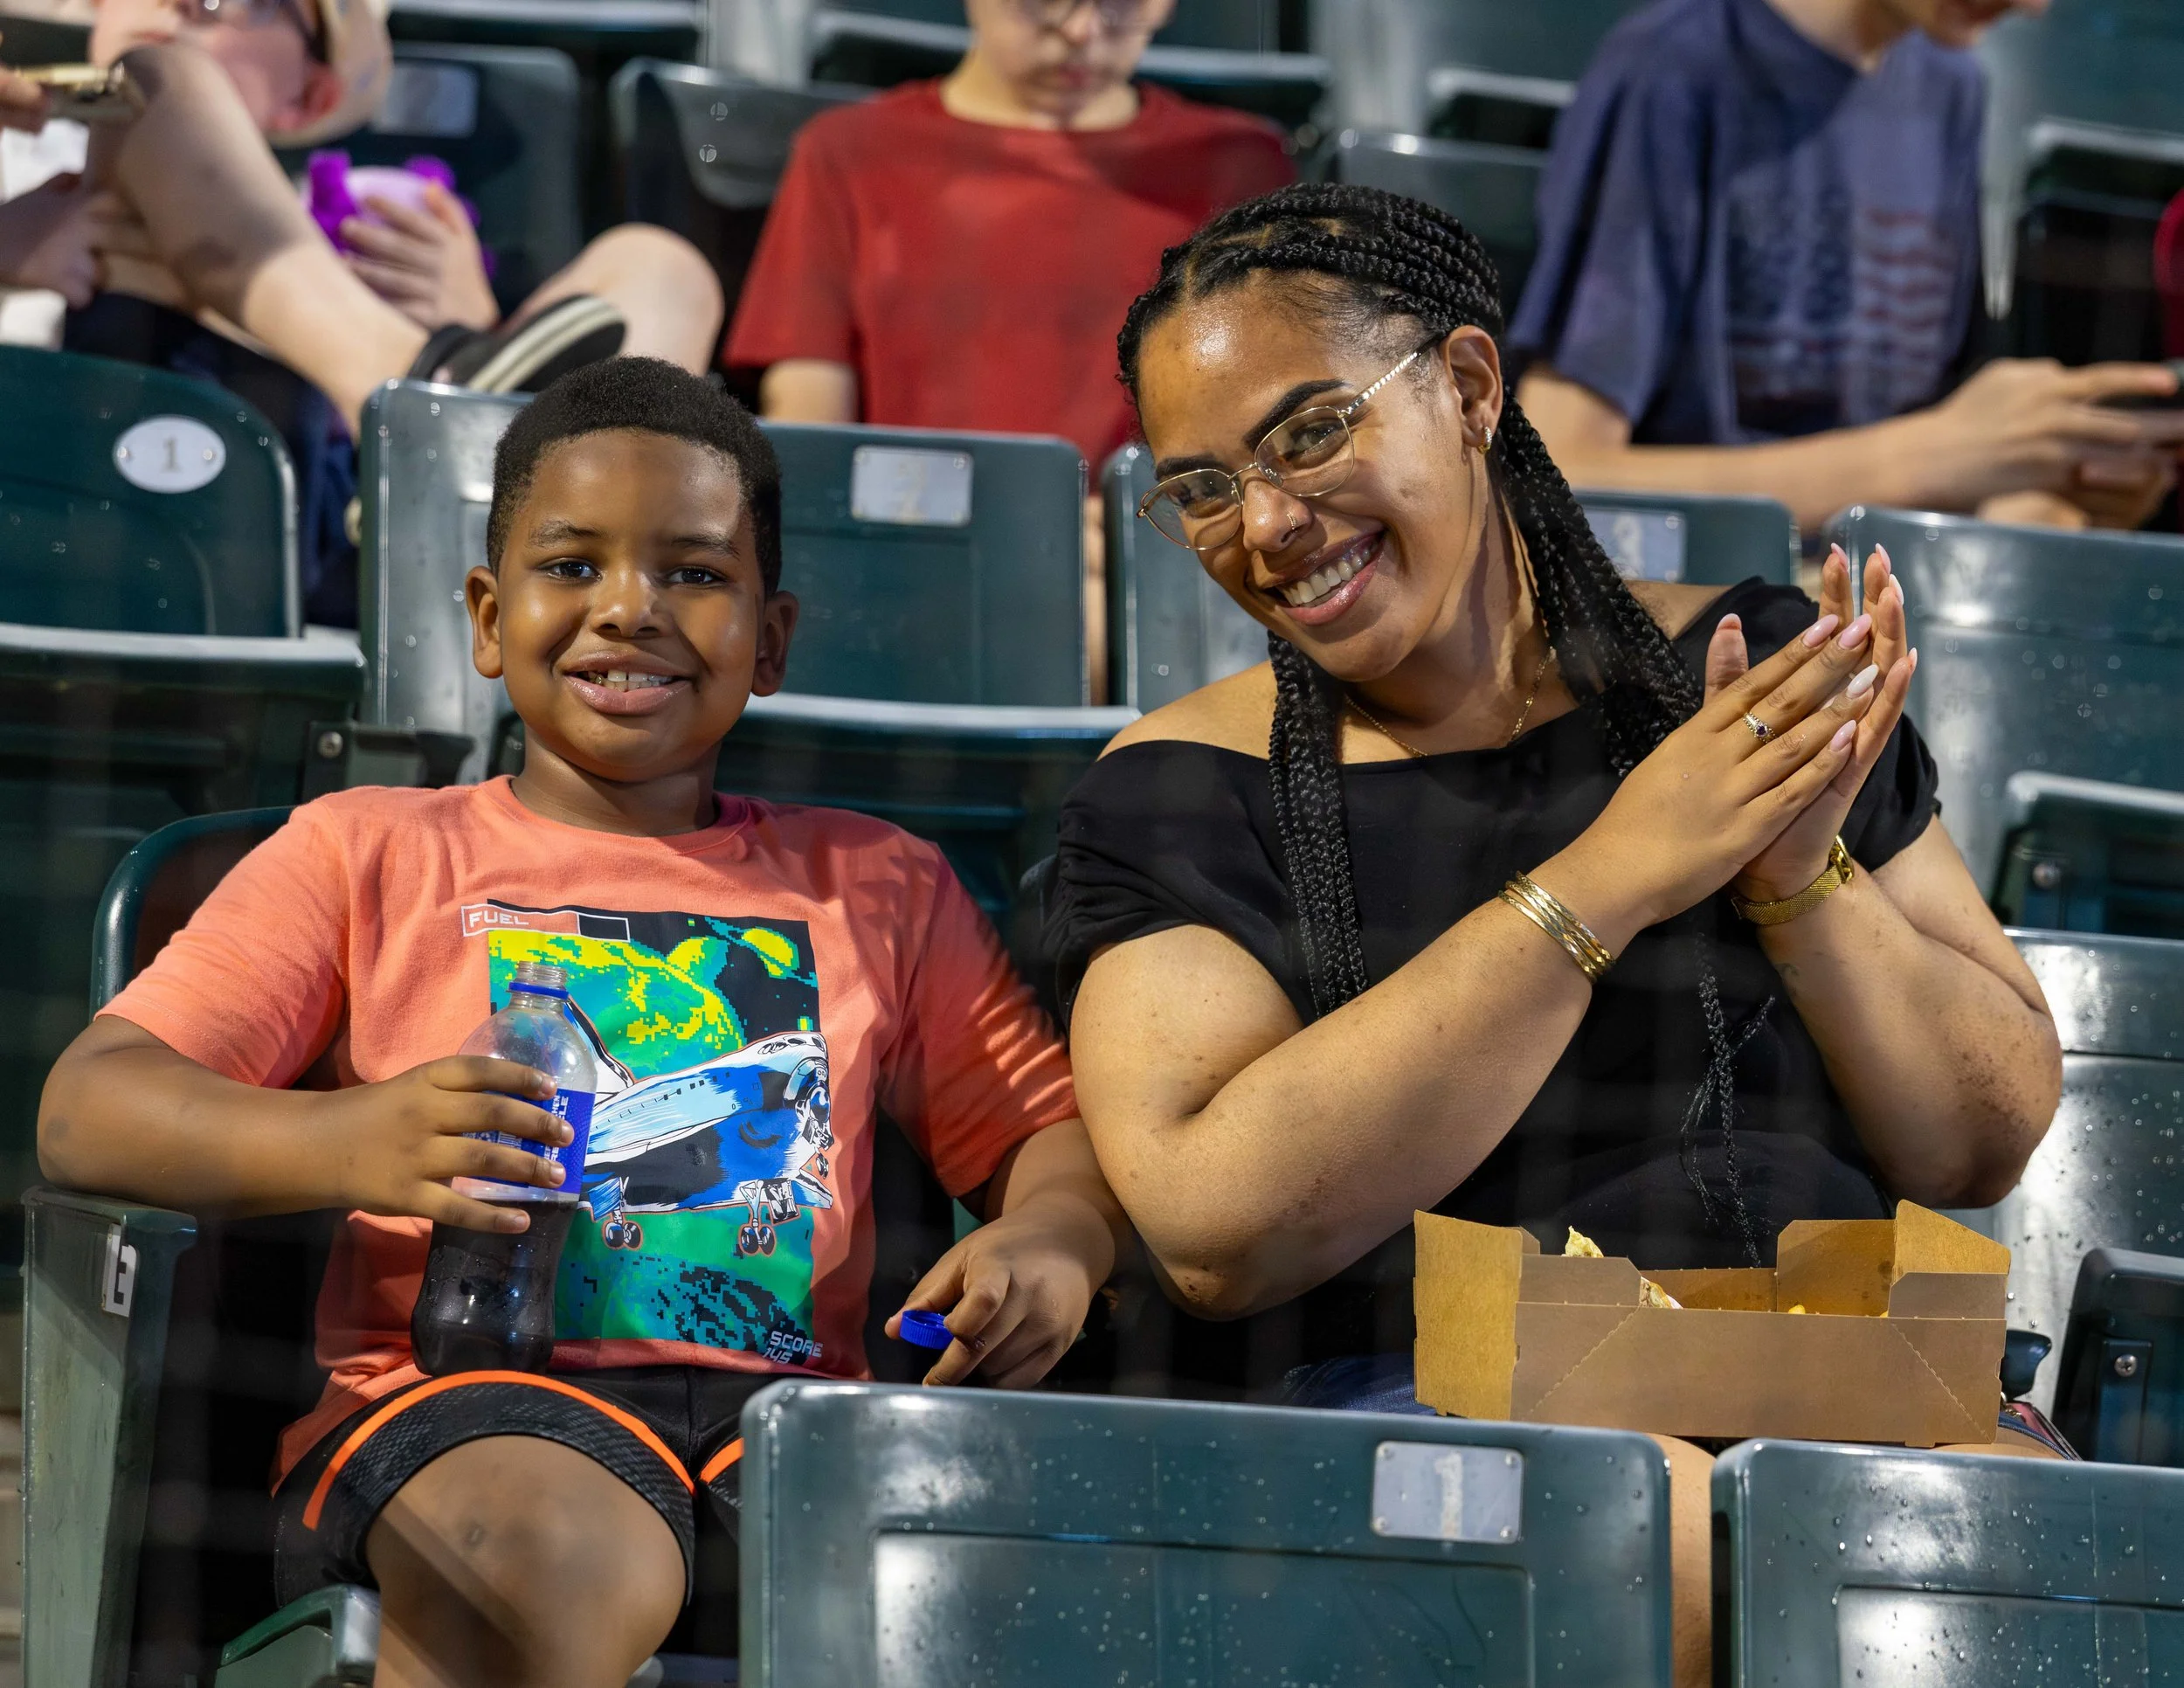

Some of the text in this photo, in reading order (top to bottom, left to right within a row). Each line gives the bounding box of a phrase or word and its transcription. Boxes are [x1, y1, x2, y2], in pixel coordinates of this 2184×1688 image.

[162, 437, 182, 473] 1
[469, 910, 529, 927] FUEL
[763, 1347, 793, 1364] 145
[771, 1331, 824, 1358] SCORE
[1434, 1450, 1463, 1539] 1
